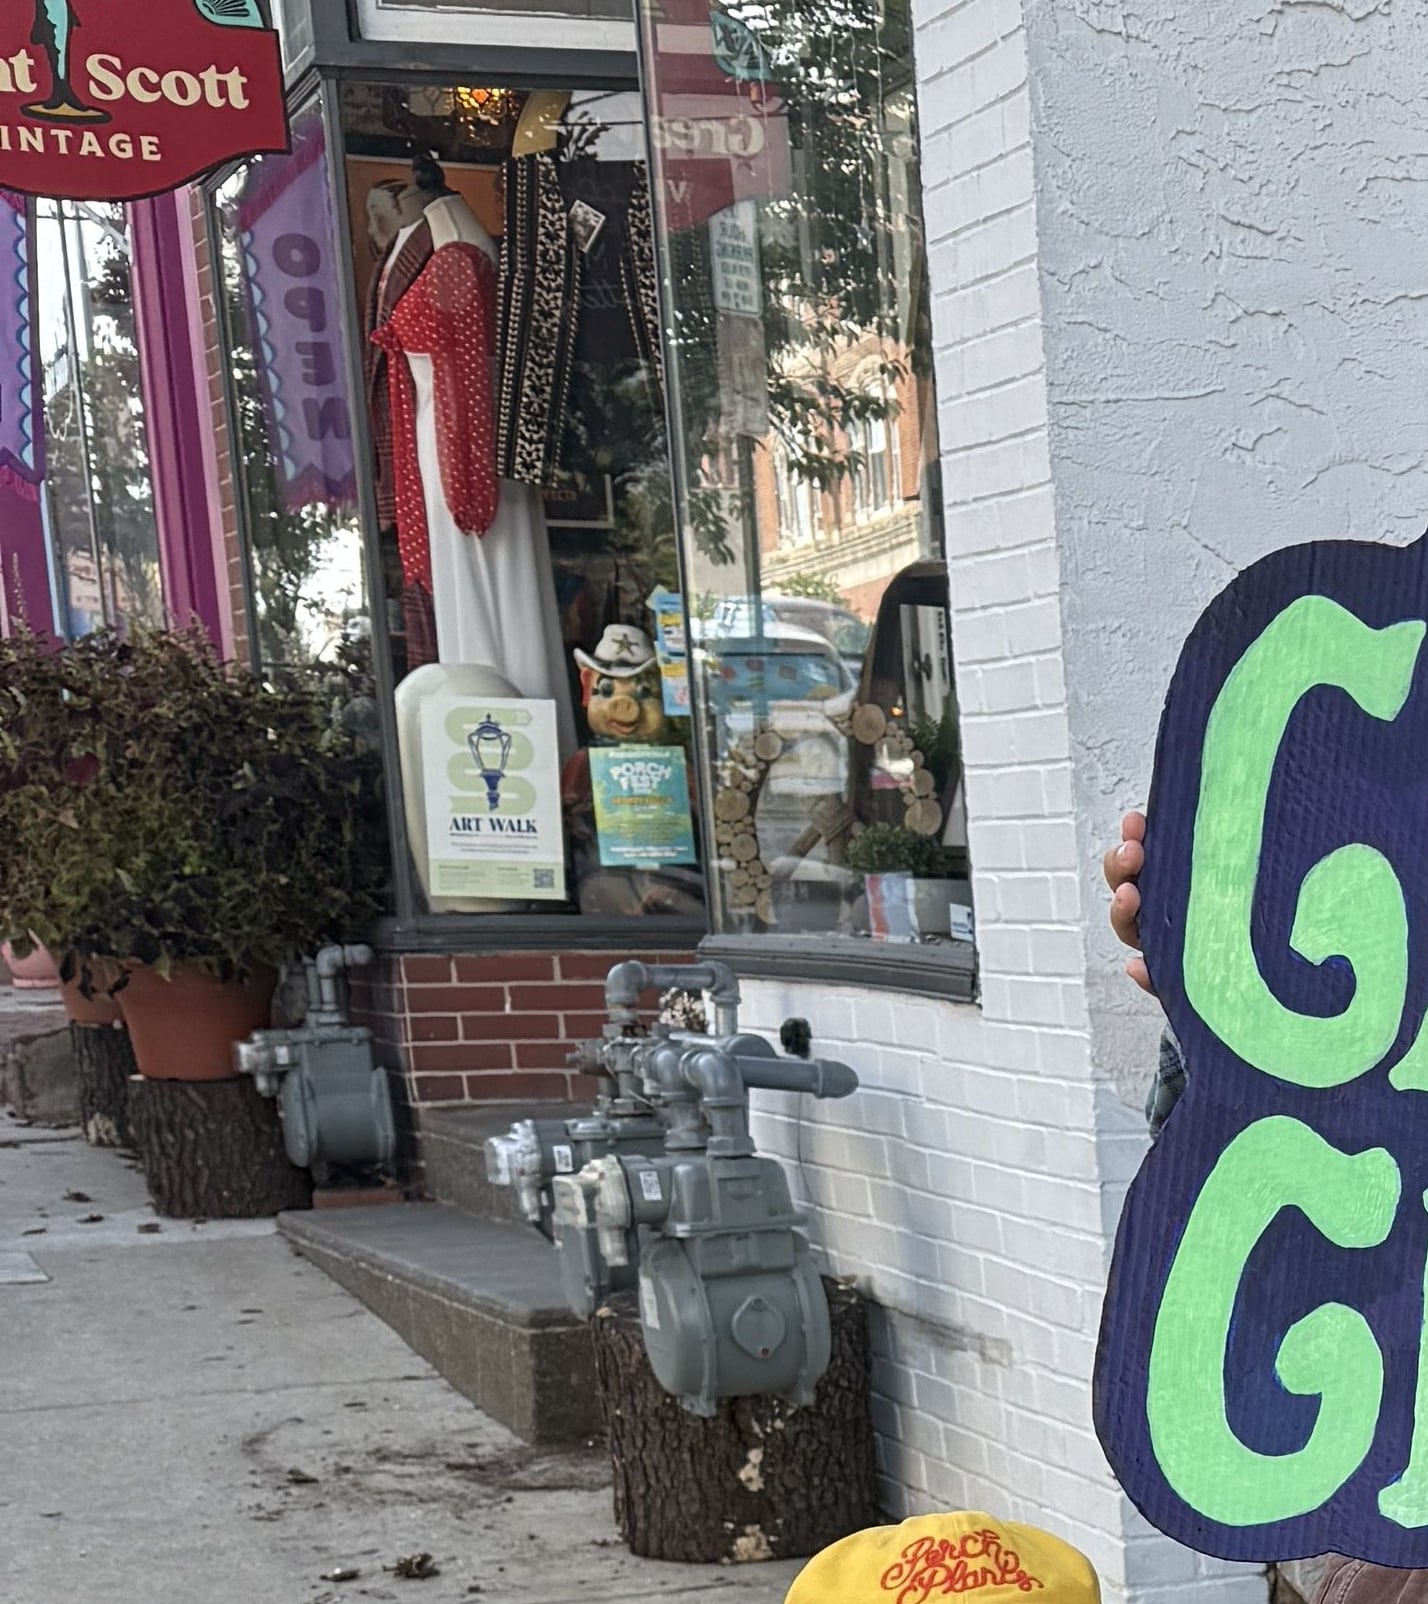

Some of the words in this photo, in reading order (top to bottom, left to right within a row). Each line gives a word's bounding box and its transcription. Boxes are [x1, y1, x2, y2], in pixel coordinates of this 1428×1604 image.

[85, 53, 250, 110] Scott
[609, 761, 672, 780] PORCH
[621, 773, 661, 790] FEST
[449, 817, 484, 833] ART
[488, 817, 537, 834] WALK
[880, 1529, 1004, 1590] Perch
